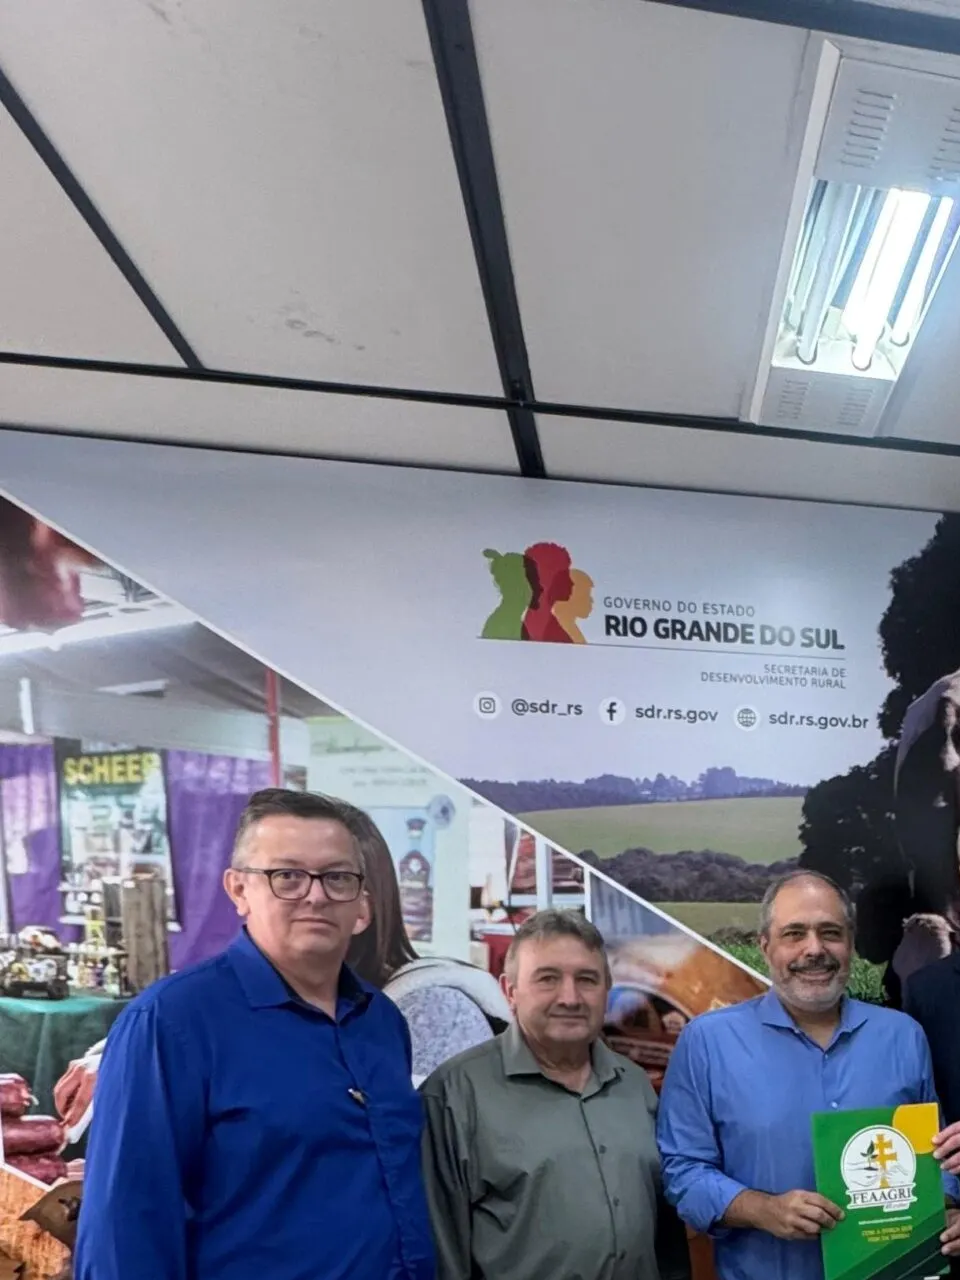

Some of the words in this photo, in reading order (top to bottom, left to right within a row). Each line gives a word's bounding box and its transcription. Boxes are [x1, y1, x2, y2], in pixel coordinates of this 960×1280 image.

[603, 596, 672, 612] GOVERNO
[677, 601, 698, 614] DO
[702, 602, 755, 617] ESTADO
[604, 614, 648, 638] RIO
[653, 618, 755, 645] GRANDE
[759, 624, 796, 647] DO
[800, 627, 846, 650] SUL
[763, 663, 828, 677] SECRETARIA
[831, 667, 847, 678] DE
[700, 671, 808, 687] DESENVOLVIMENTO
[811, 678, 847, 689] RURAL
[511, 698, 583, 716] @sdr_rs
[635, 704, 719, 724] sdr.rs.gov
[768, 711, 869, 730] sdr.rs.gov.br
[852, 1187, 912, 1205] FEAAGRI
